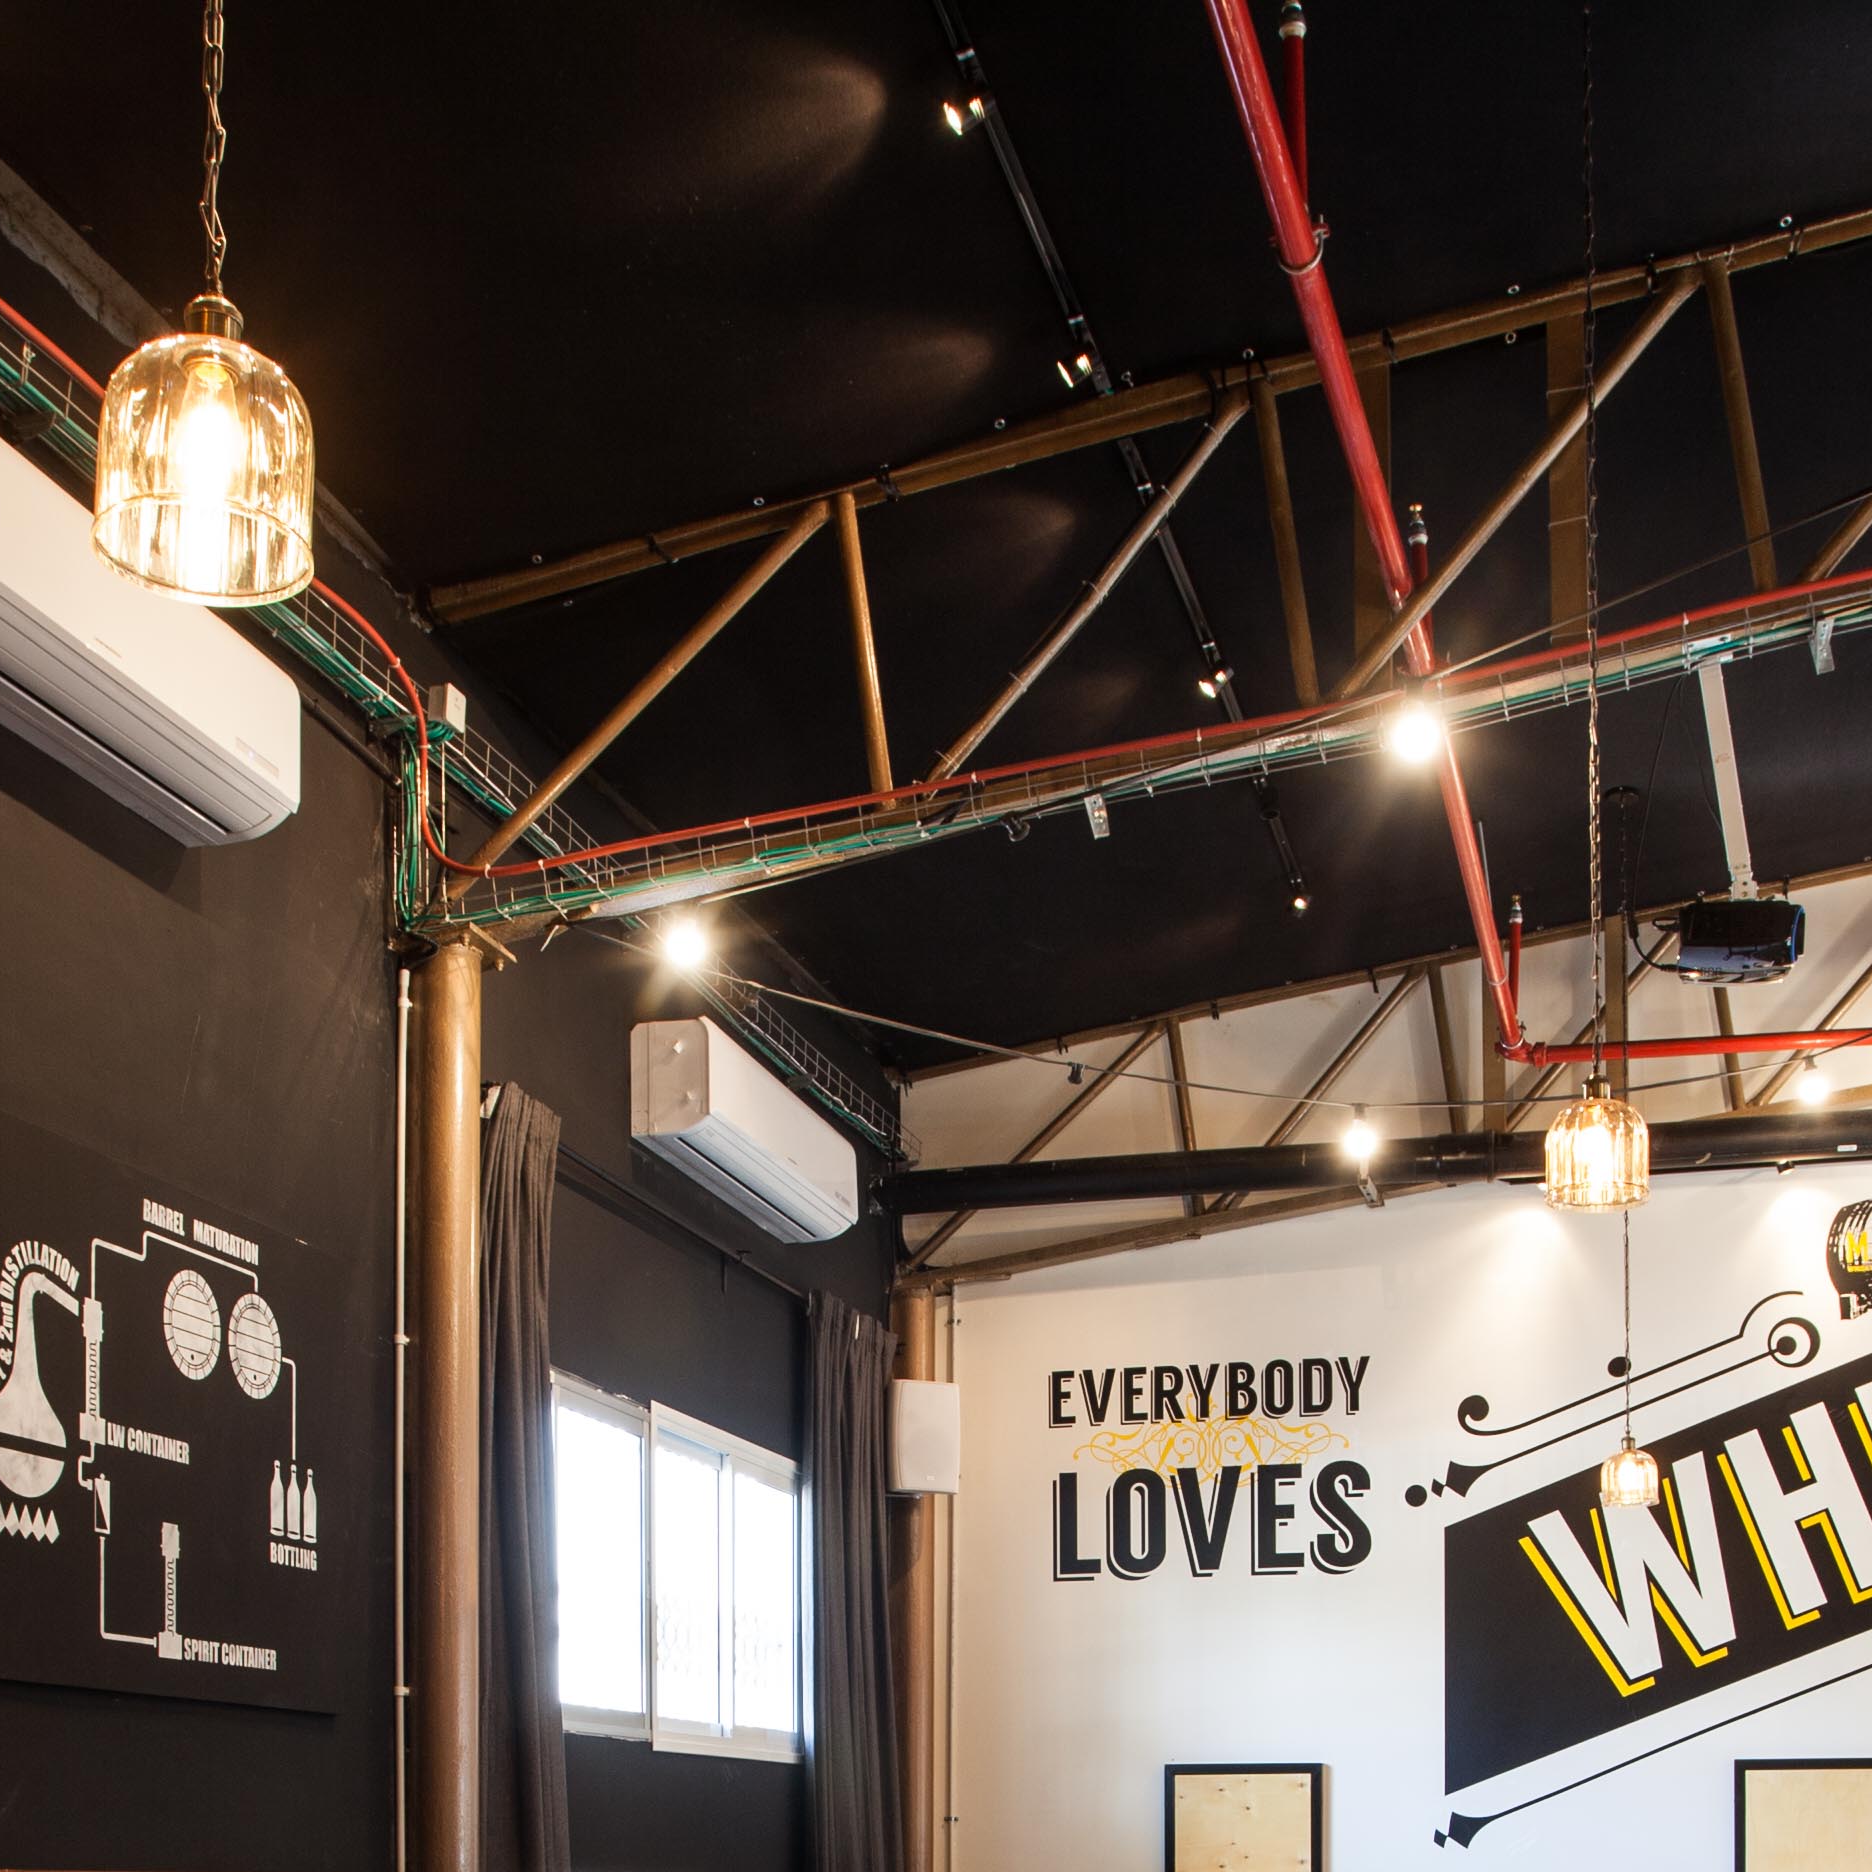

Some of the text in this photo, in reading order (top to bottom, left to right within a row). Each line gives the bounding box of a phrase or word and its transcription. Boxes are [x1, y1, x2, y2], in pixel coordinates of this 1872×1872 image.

[142, 1197, 260, 1267] BARREL MATURATION
[0, 1346, 14, 1365] &
[1047, 1353, 1371, 1428] EVERYBODY
[107, 1421, 190, 1465] LW CONTAINER
[1049, 1459, 1375, 1583] LOVES
[270, 1541, 318, 1572] BOTTLING
[184, 1637, 278, 1671] SPIRIT CONTAINER
